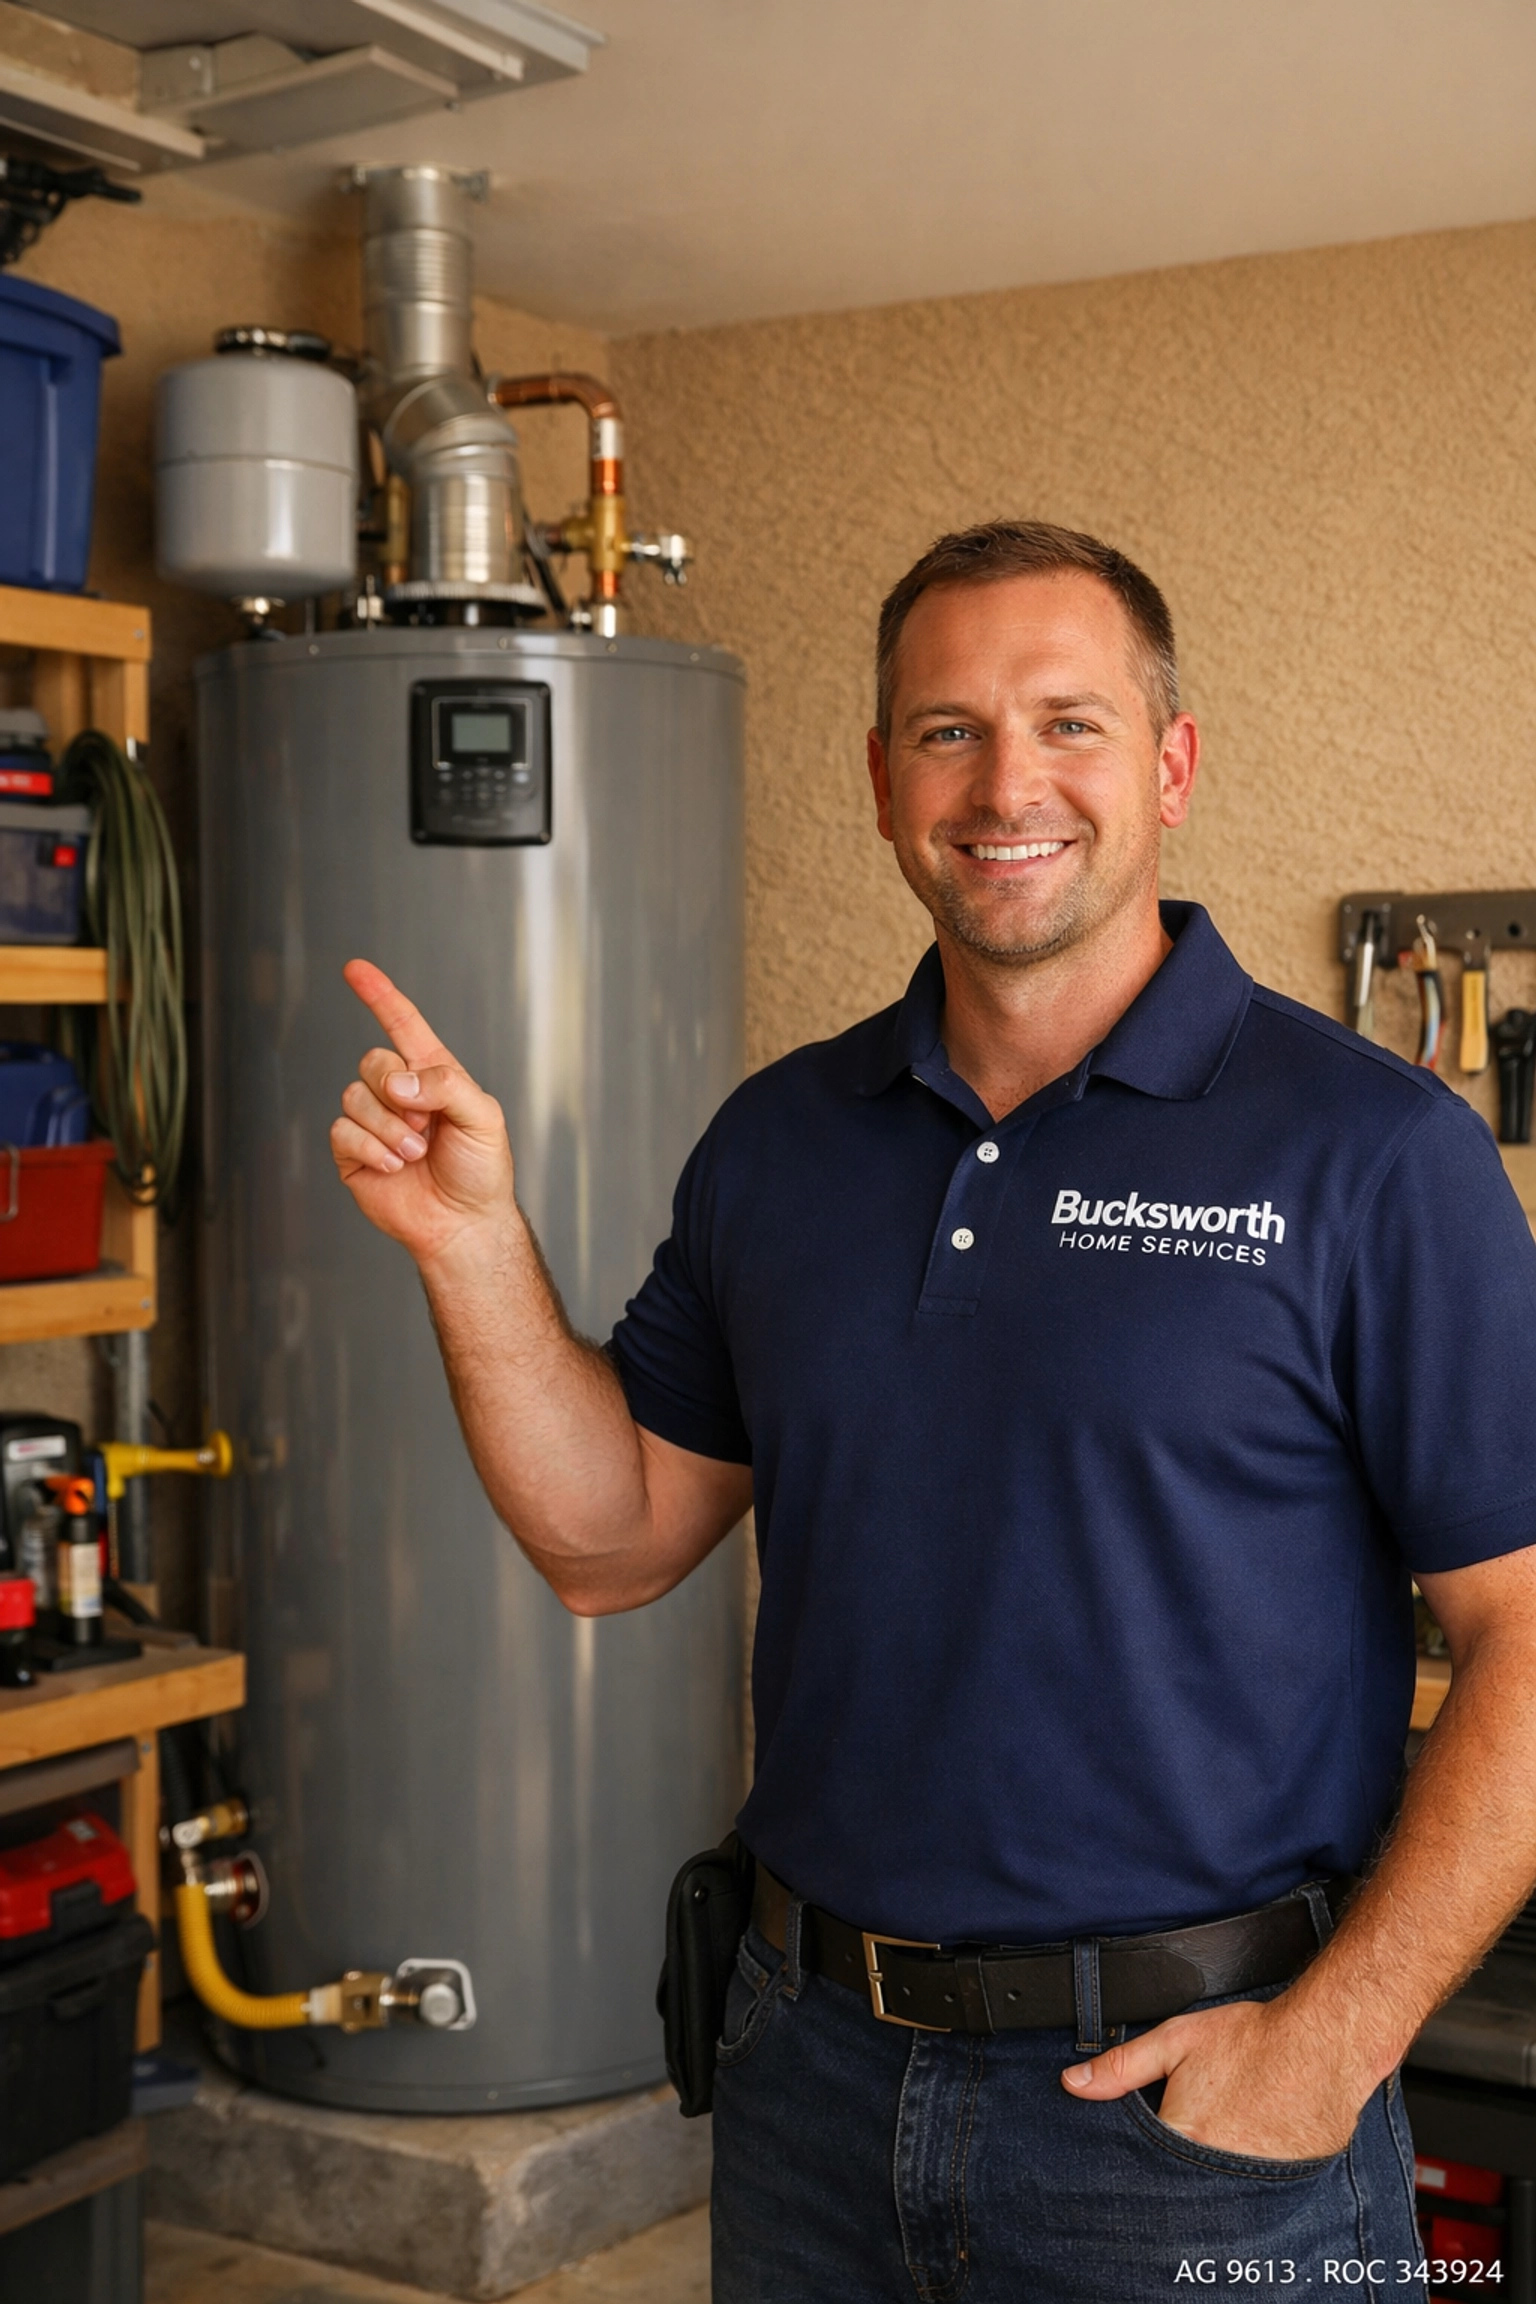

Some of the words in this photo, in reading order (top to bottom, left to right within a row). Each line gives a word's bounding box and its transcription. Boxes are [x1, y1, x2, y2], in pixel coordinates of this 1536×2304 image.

[1051, 1189, 1287, 1245] Bucksworth
[1059, 1230, 1133, 1252] HOME
[1141, 1235, 1267, 1266] SERVICES
